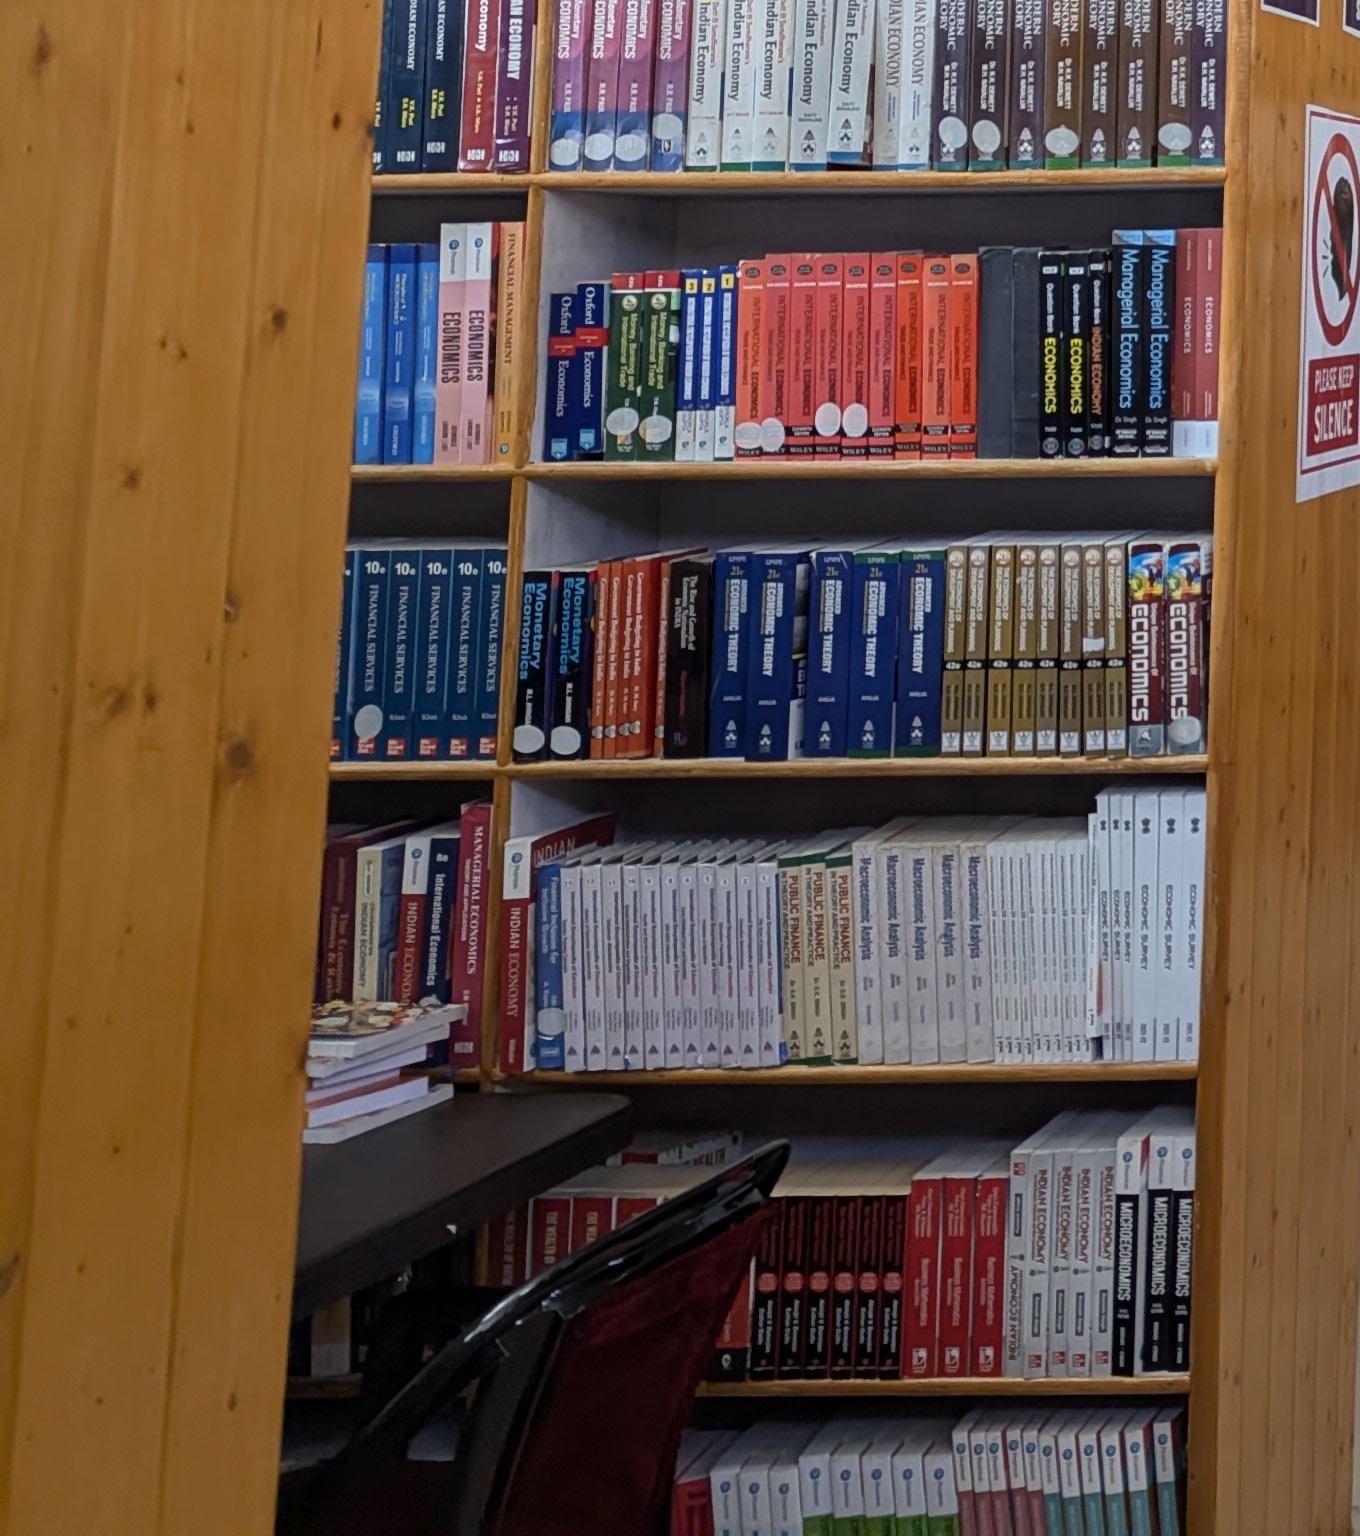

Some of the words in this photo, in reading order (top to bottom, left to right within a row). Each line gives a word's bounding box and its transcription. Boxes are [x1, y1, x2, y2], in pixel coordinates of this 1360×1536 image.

[407, 23, 416, 70] ECONOMY
[436, 14, 445, 61] ECONOMY
[507, 18, 523, 80] ECONOMY
[698, 2, 712, 43] Indian
[692, 46, 709, 104] Economy
[728, 42, 744, 101] Economy
[800, 42, 818, 105] Economy
[839, 32, 858, 94] Economy
[886, 29, 902, 87] ECONOMY
[559, 295, 572, 334] Oxford
[585, 287, 596, 325] Oxford
[688, 282, 695, 291] 3
[1117, 249, 1139, 329] Managerial
[1147, 249, 1170, 329] Managerial
[441, 311, 461, 384] ECONOMICS
[467, 310, 485, 382] ECONOMICS
[1119, 334, 1138, 409] Economics
[1149, 334, 1169, 409] Economics
[555, 360, 570, 417] Economics
[583, 350, 595, 408] Economics
[1044, 338, 1057, 414] ECONOMICS
[1070, 339, 1083, 415] ECONOMICS
[1315, 367, 1337, 393] PLEASE
[1314, 399, 1353, 443] SILENCE
[365, 561, 386, 574] 10e
[426, 562, 448, 575] 10e
[366, 584, 379, 642] FINANCIAL
[428, 586, 441, 642] FINANCIAL
[519, 583, 535, 681] Economics
[530, 583, 547, 670] Monetary
[559, 577, 574, 675] Economics
[570, 577, 585, 664] Monetary
[364, 643, 376, 693] SERVICES
[426, 644, 438, 694] SERVICES
[1132, 604, 1148, 722] ECONOMICS
[471, 825, 484, 903] MANAGERIAL
[813, 871, 823, 912] PUBLIC
[467, 904, 480, 975] ECONOMICS
[814, 913, 825, 961] FINANCE
[1117, 1202, 1134, 1301] MICROECONOMICS
